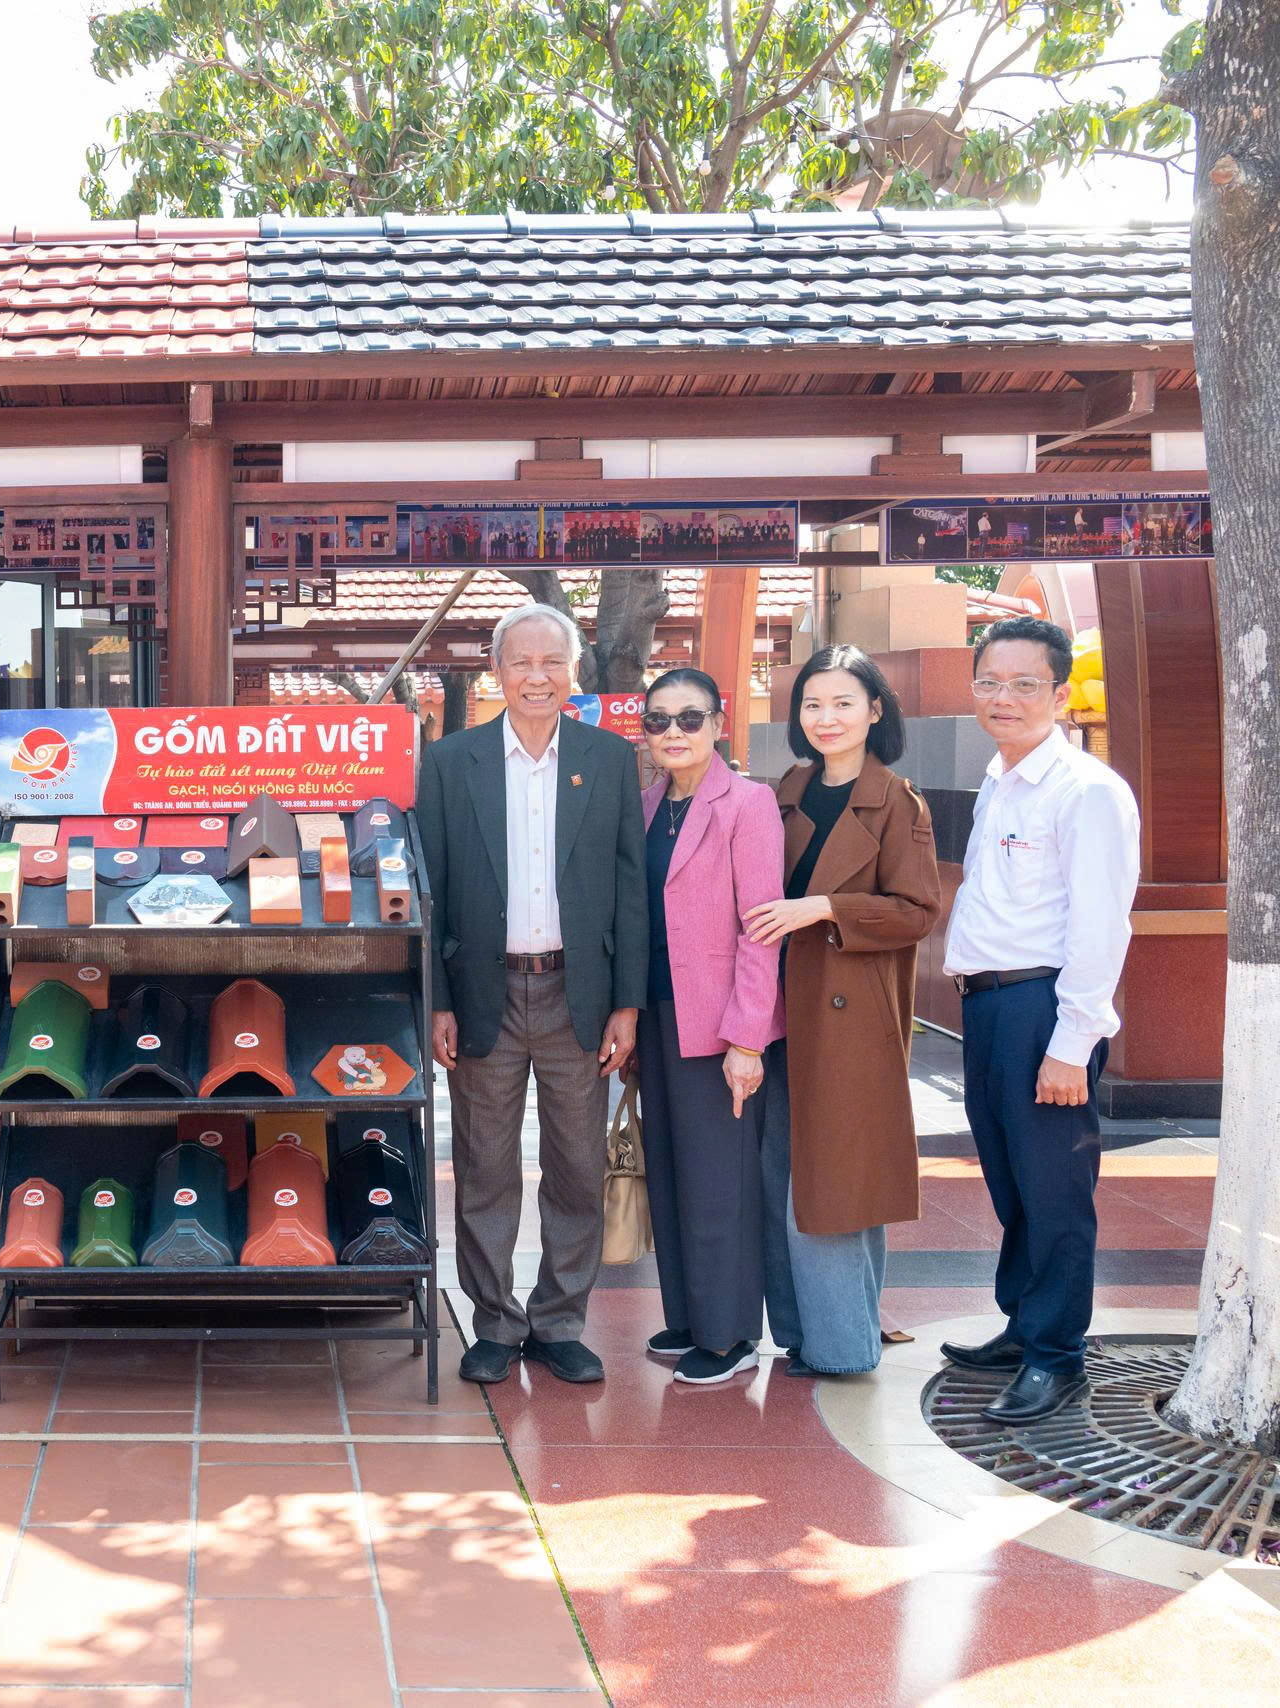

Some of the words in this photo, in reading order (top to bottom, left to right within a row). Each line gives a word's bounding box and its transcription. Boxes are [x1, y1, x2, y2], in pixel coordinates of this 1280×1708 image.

[134, 714, 226, 755] GỐM
[237, 713, 307, 754] ĐẤT
[316, 716, 388, 762] VIỆT
[136, 764, 162, 780] Tự
[164, 764, 194, 777] hào
[199, 763, 227, 777] đất
[230, 764, 252, 777] sét
[255, 767, 296, 779] nung
[301, 762, 337, 779] Việt
[341, 762, 385, 776] Nam
[168, 784, 210, 798] GẠCH,
[212, 782, 246, 796] NGÓI
[249, 782, 295, 795] KHÔNG
[298, 781, 320, 794] RÊU
[323, 780, 355, 794] MỐC
